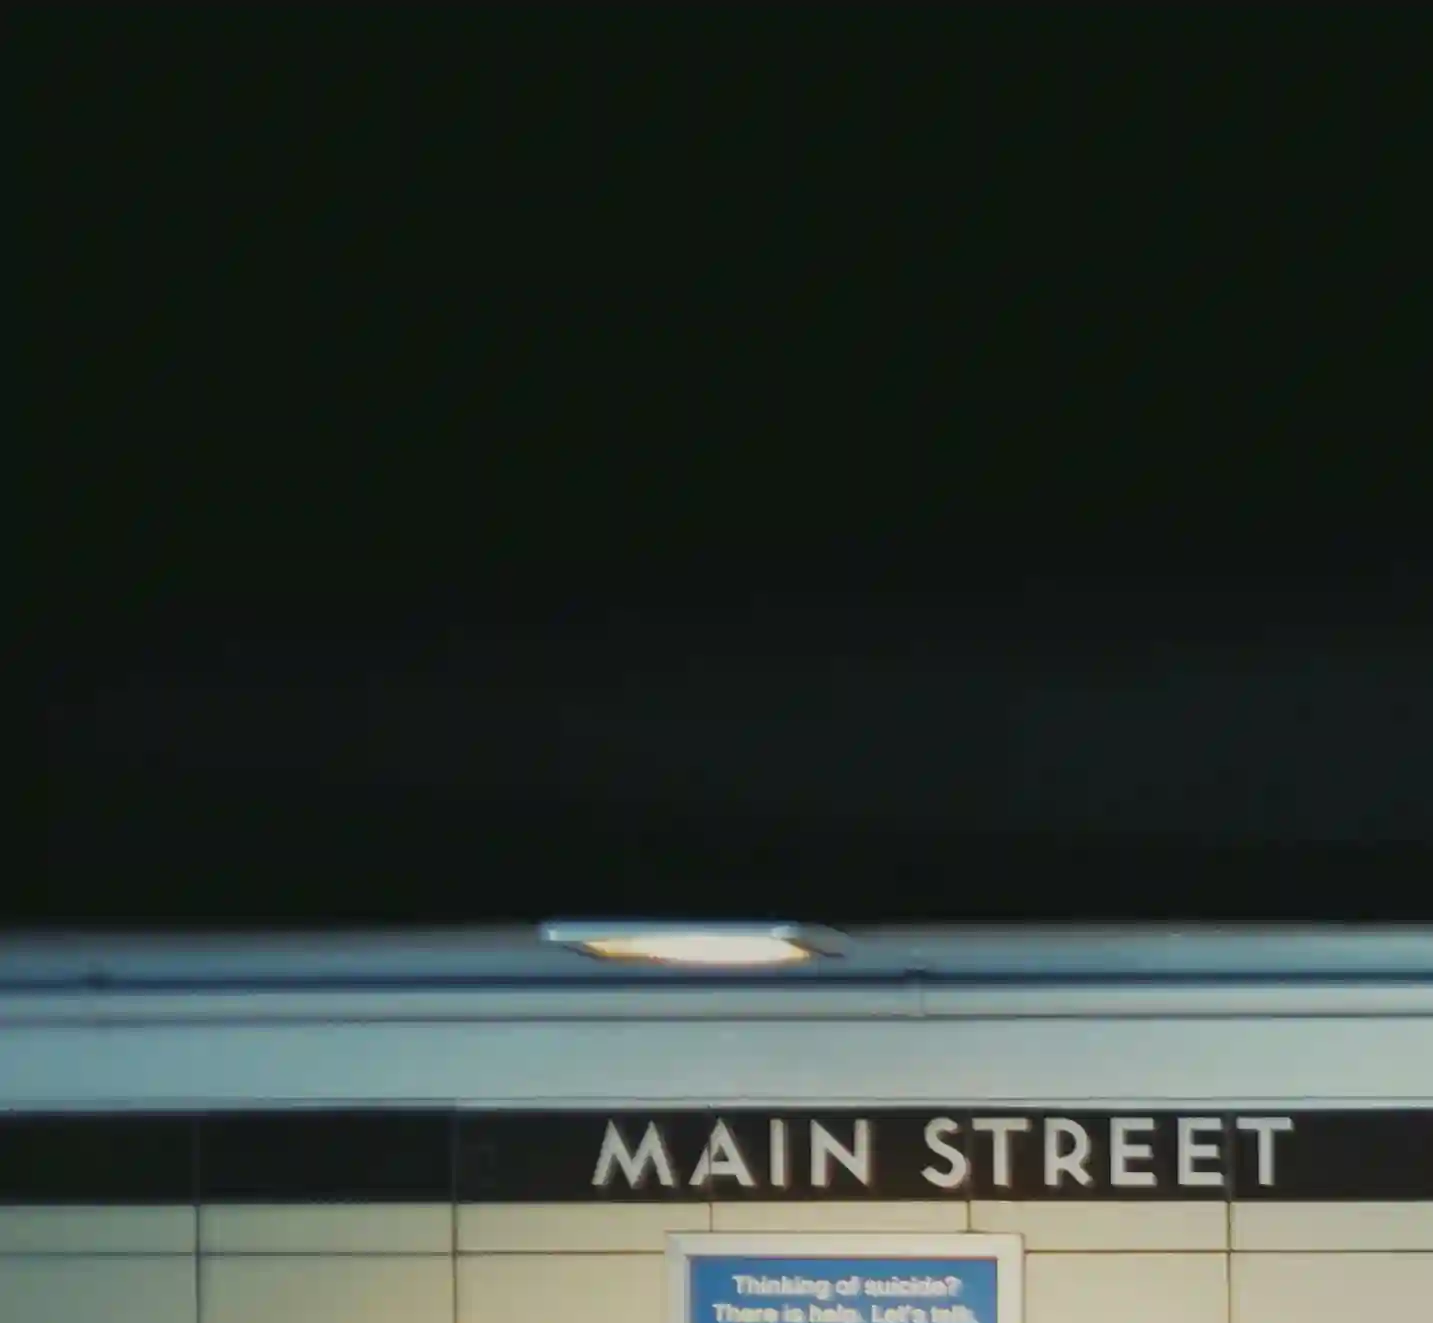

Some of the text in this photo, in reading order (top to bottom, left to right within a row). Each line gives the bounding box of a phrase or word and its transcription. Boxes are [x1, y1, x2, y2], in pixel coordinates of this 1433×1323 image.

[591, 1117, 1294, 1188] MAIN STREET
[731, 1274, 964, 1300] Thinking of suicide?
